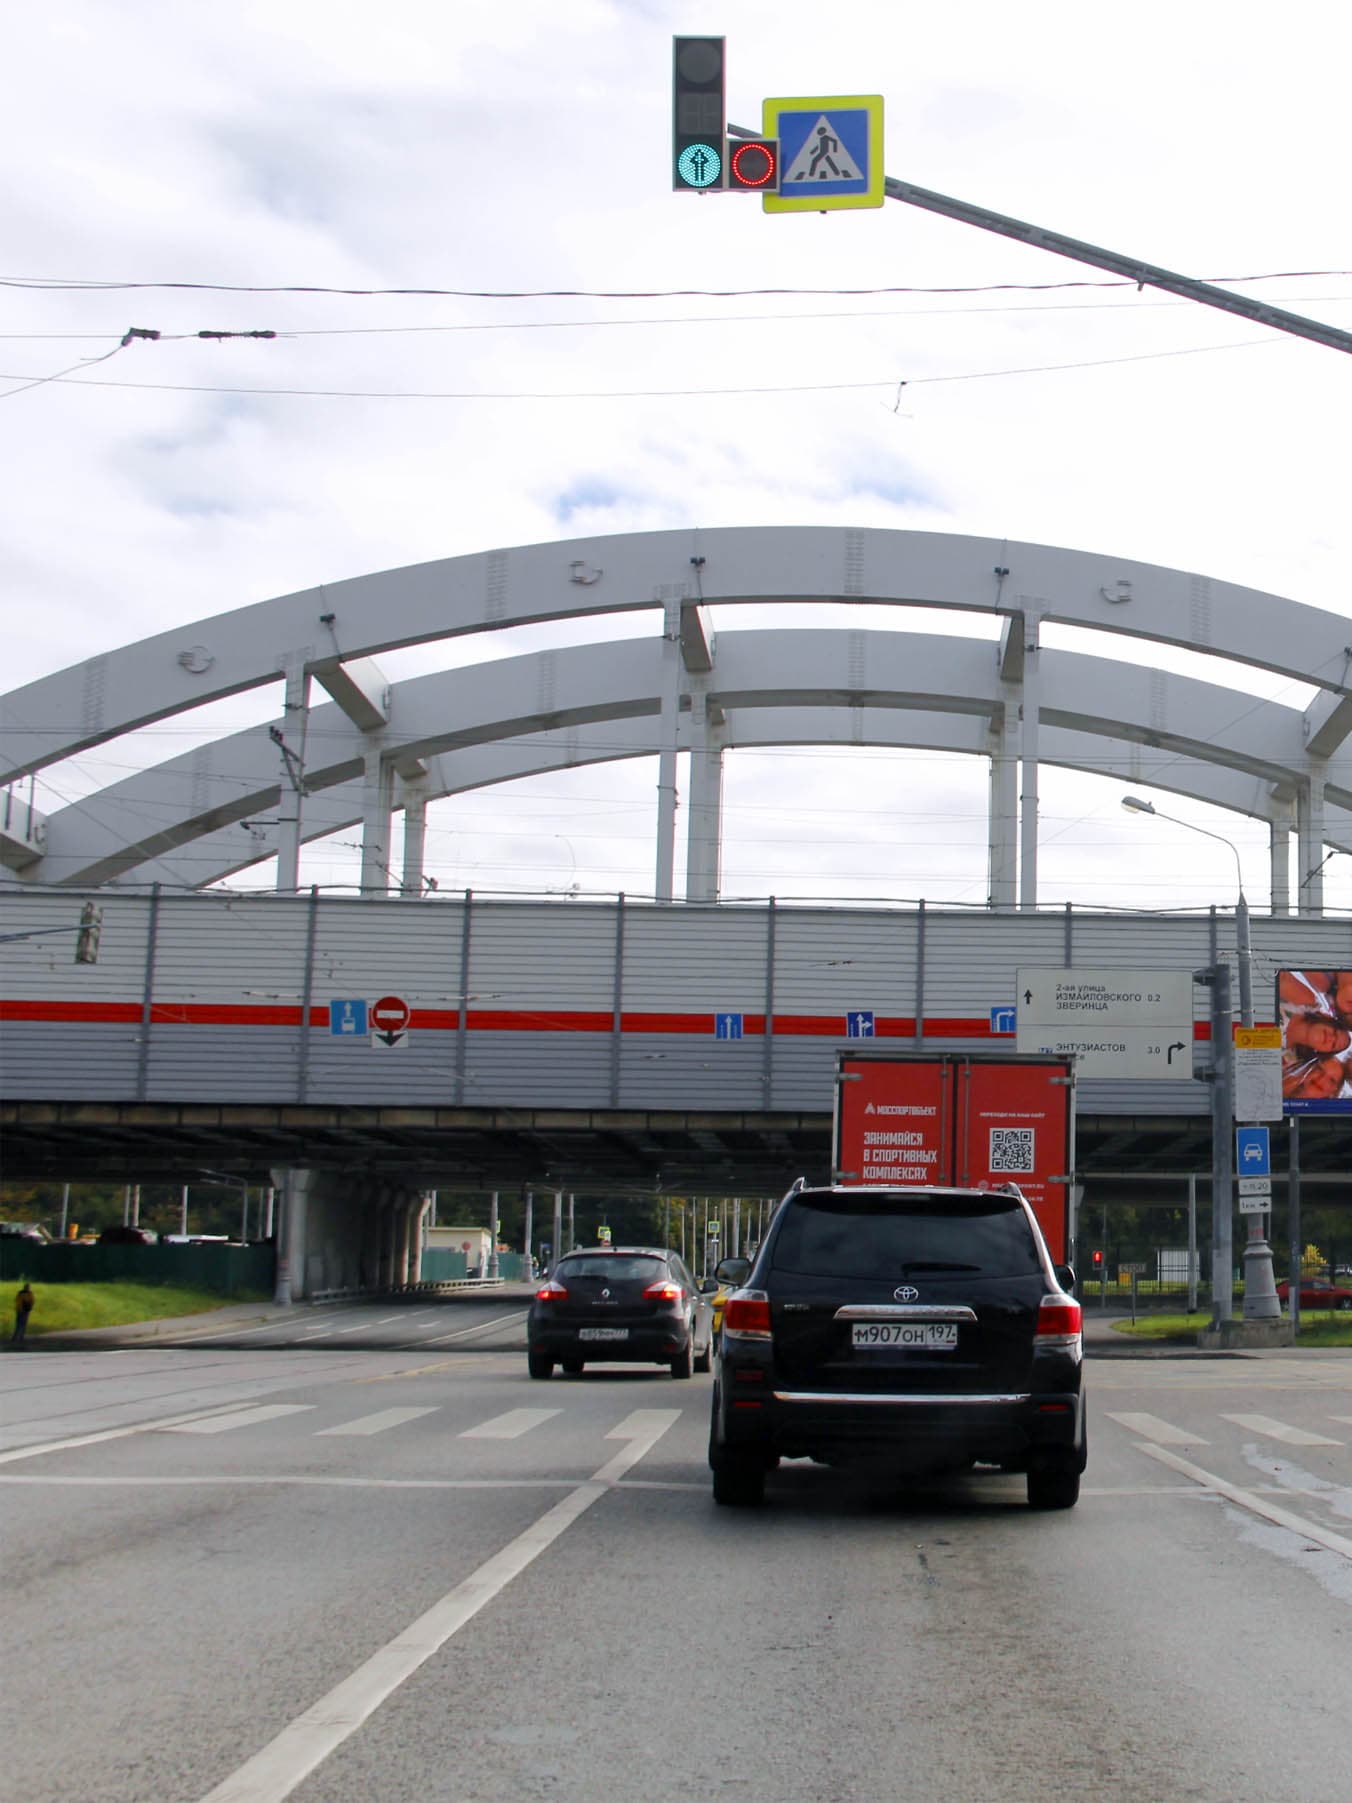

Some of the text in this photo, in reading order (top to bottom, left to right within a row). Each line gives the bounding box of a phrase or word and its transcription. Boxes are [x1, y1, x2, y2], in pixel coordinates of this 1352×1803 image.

[1078, 985, 1106, 993] улица
[1056, 1002, 1108, 1010] ЗВЕРИНЦА
[1056, 1042, 1126, 1052] ЭНТУЗИАСТОВ
[863, 1130, 923, 1146] ЗАНИМАЙСЯ
[863, 1149, 938, 1163] В СПОРТИВНЫХ
[863, 1166, 928, 1180] КОМПЛЕКСАХ
[928, 1325, 953, 1338] 197
